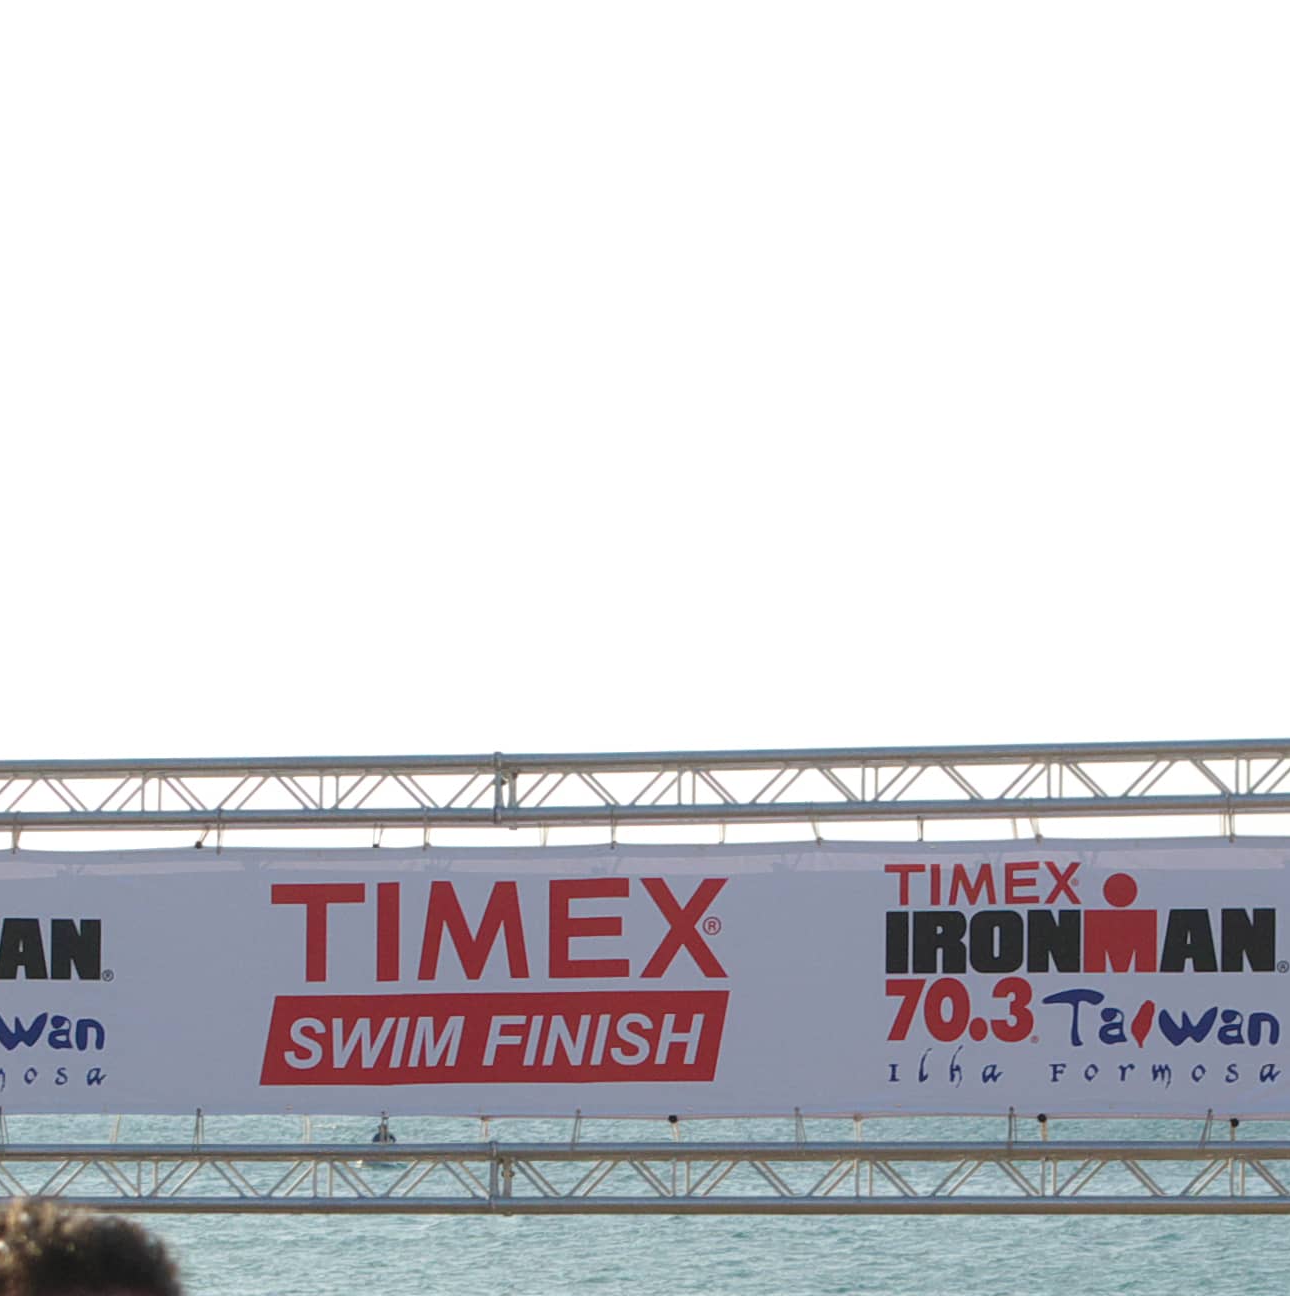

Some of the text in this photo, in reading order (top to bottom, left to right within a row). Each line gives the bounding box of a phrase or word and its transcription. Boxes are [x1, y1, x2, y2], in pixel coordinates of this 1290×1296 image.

[884, 861, 1082, 906] TIMEX
[271, 877, 729, 983] TIMEX
[885, 908, 1276, 974] IRONMAN
[284, 1013, 705, 1069] SWIM FINISH
[885, 976, 1280, 1048] 70.3 Taiwan
[1049, 1062, 1281, 1089] Formosa
